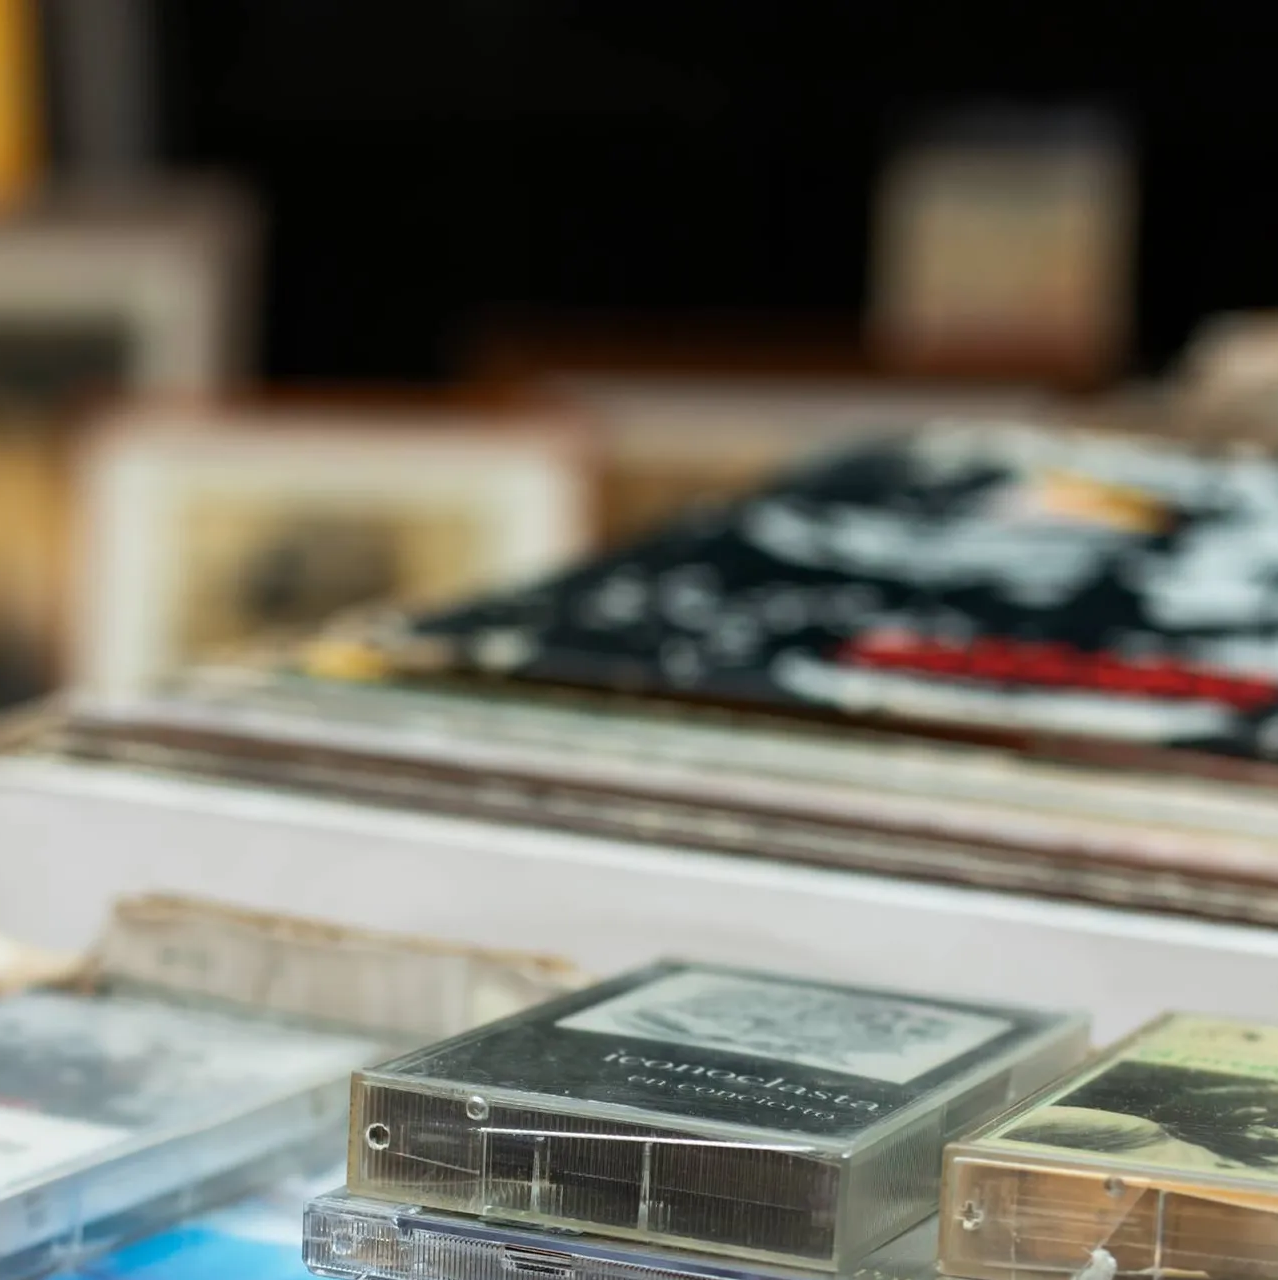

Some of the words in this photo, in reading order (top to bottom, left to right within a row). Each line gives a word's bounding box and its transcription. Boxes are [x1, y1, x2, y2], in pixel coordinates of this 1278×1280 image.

[603, 1049, 880, 1112] iconoclasta
[626, 1074, 667, 1088] en
[676, 1081, 836, 1120] concierto
